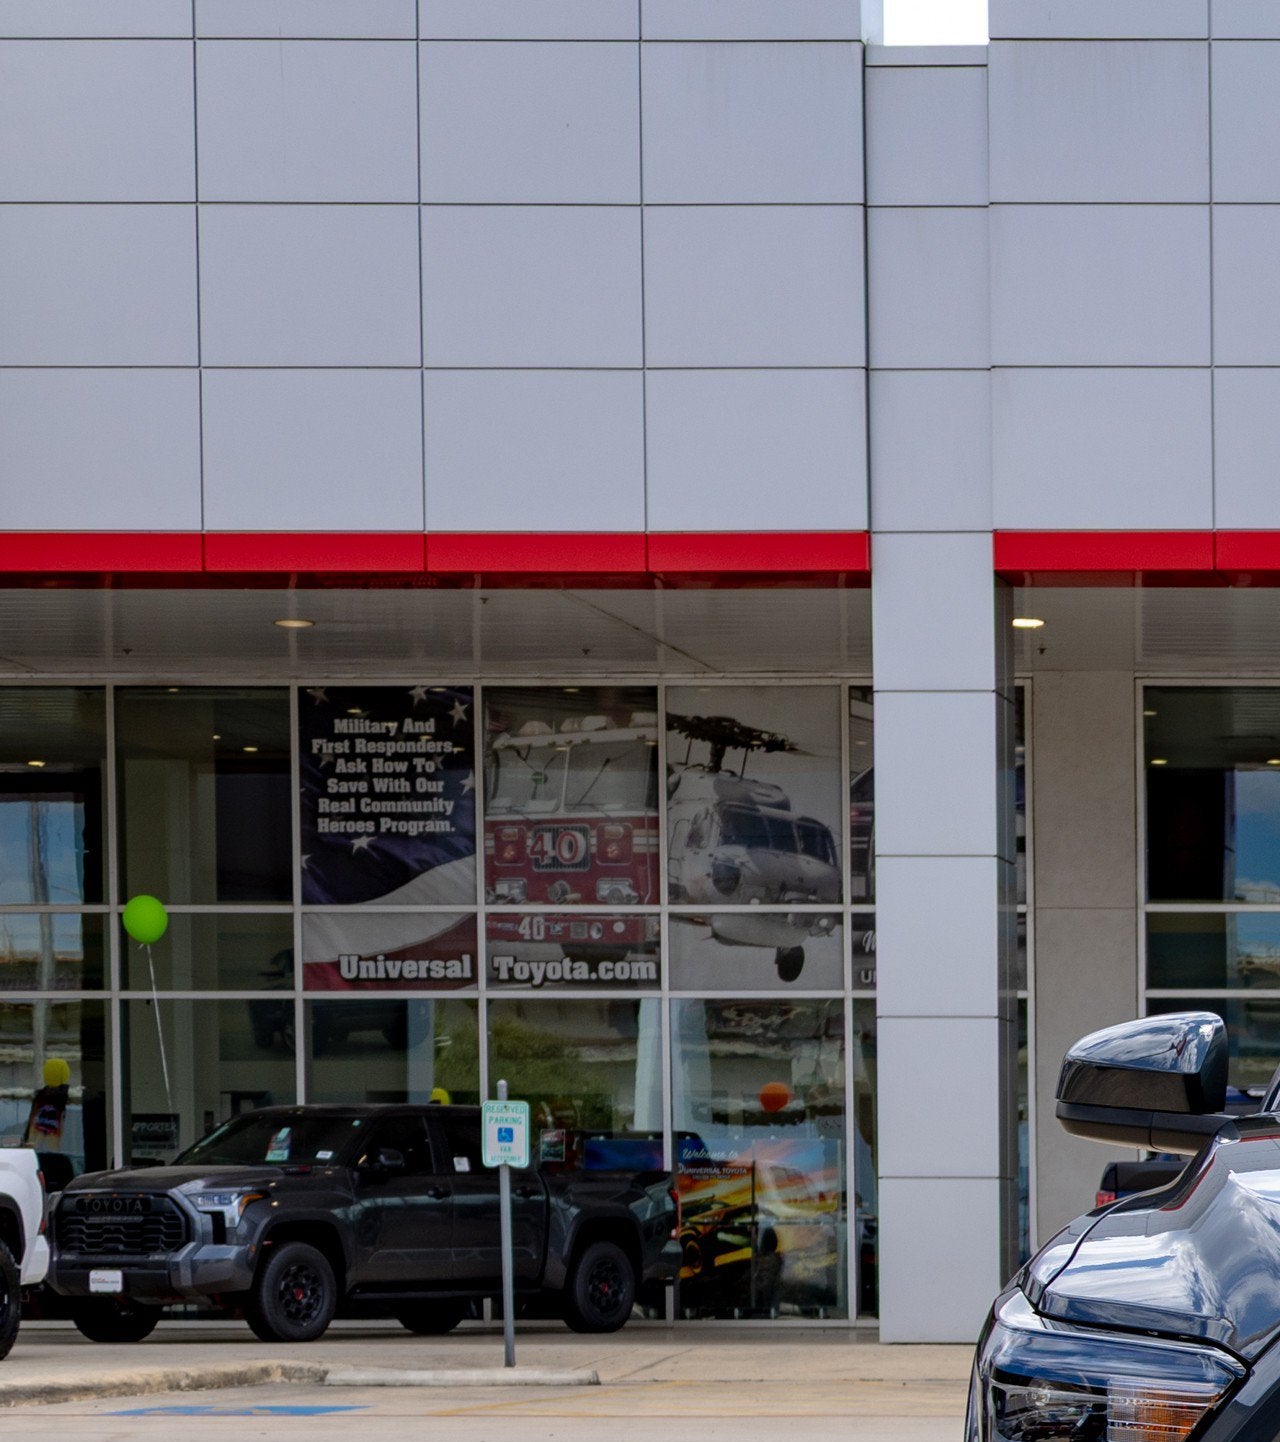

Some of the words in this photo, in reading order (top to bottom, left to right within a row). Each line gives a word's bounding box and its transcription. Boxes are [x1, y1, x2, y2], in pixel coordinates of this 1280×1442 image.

[334, 718, 398, 736] Military
[403, 717, 435, 733] And
[312, 739, 350, 753] First
[335, 758, 367, 773] Ask
[372, 758, 408, 773] How
[413, 757, 435, 773] To
[327, 778, 368, 793] Save
[373, 777, 411, 793] With
[415, 777, 444, 793] Our
[318, 798, 356, 813] Real
[360, 798, 454, 816] Community
[317, 818, 375, 833] Heroes
[380, 817, 456, 836] Program.
[517, 915, 545, 940] 40
[339, 954, 472, 980] Universal
[492, 955, 657, 987] Toyota.com
[488, 1116, 523, 1126] PARKING
[83, 1199, 143, 1212] TOYOTA
